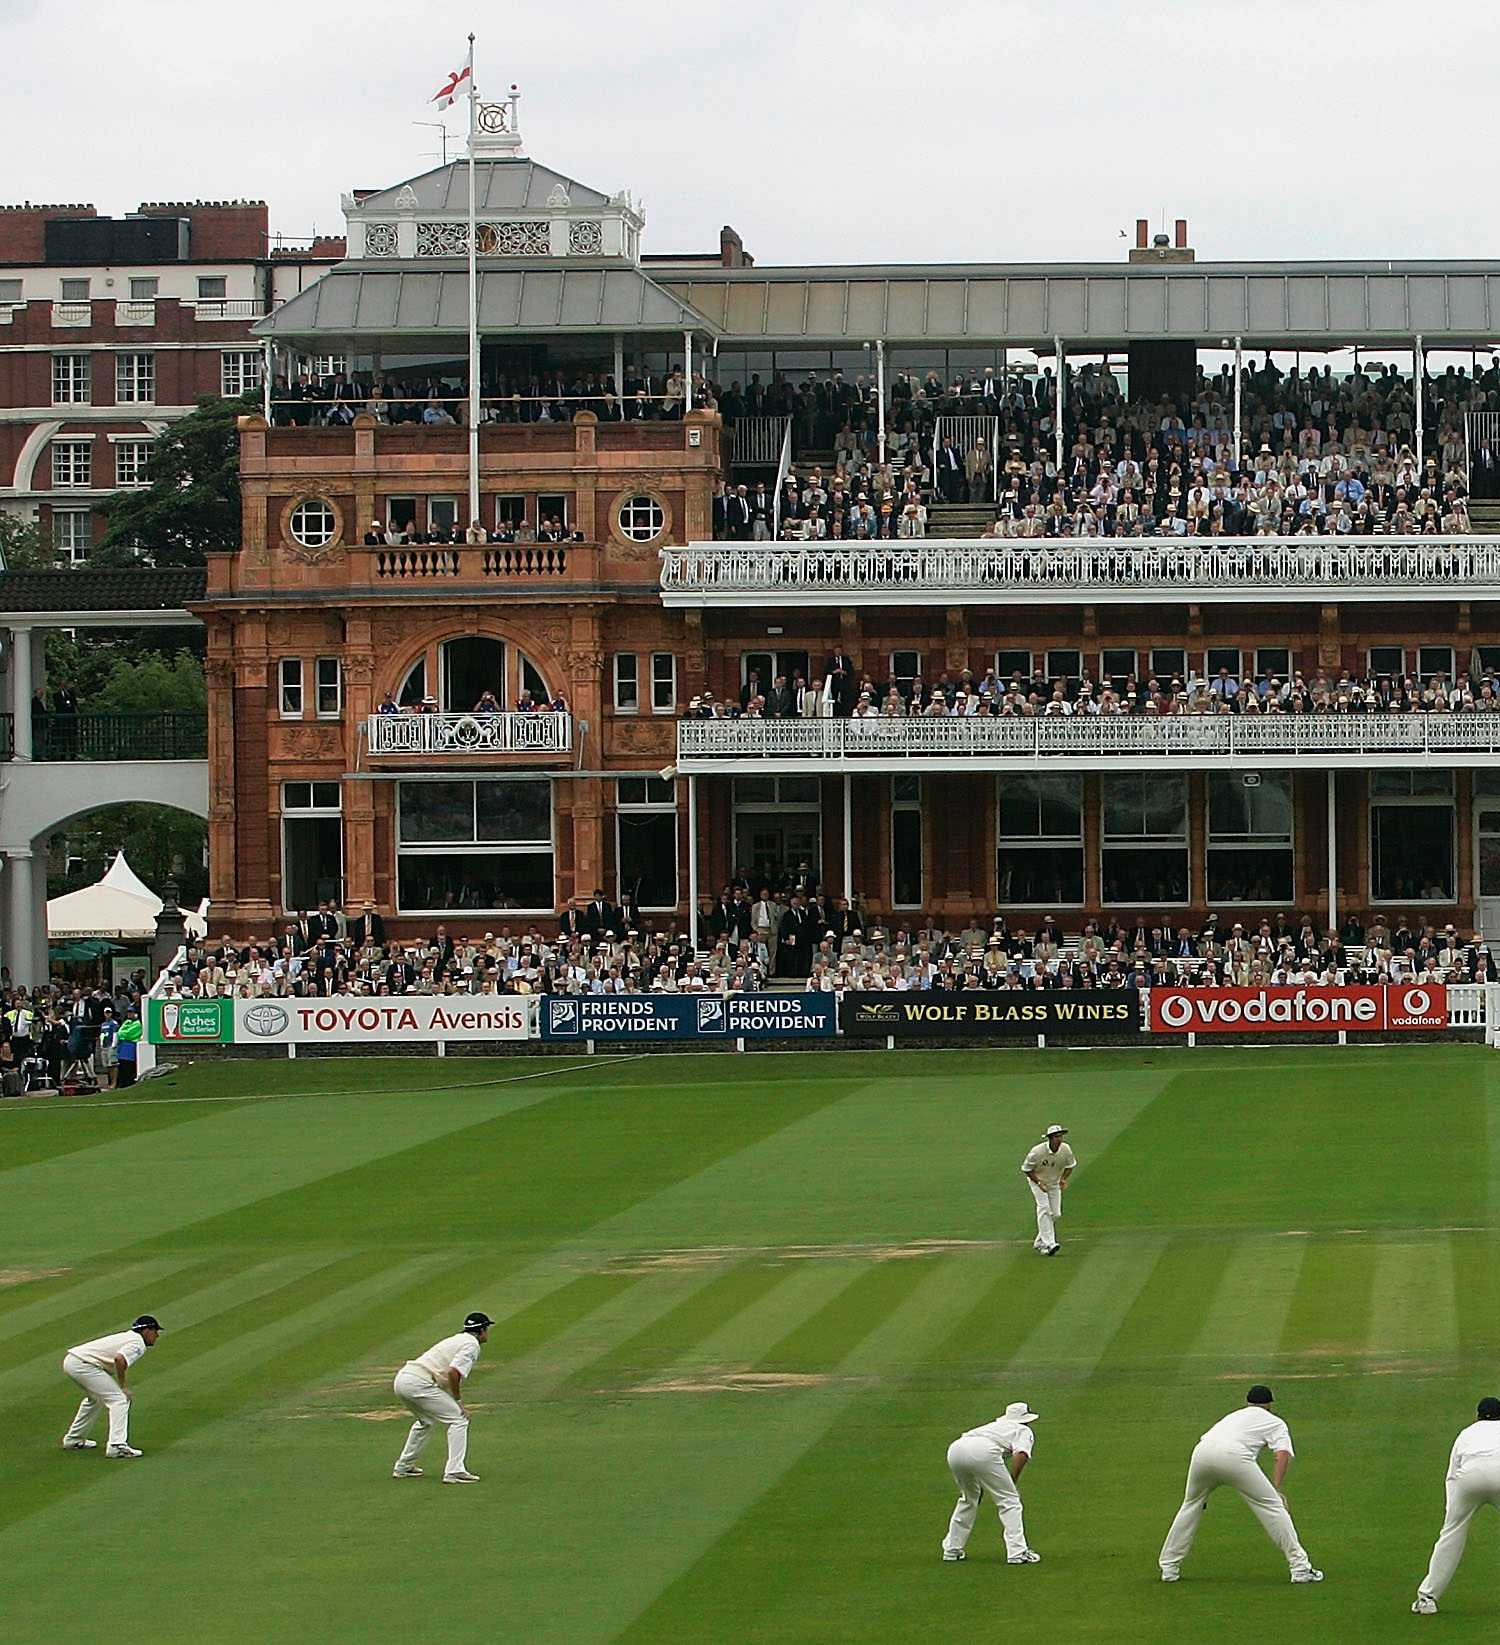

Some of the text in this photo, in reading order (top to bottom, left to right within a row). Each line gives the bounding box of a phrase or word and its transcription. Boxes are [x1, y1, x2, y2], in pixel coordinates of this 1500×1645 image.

[582, 1002, 654, 1015] FRIENDS
[729, 999, 801, 1013] FRIENDS
[904, 1003, 1129, 1021] WOLF BLASS WINES
[1197, 990, 1377, 1023] vodafone
[182, 1016, 216, 1026] Ashes
[297, 1006, 522, 1031] TOYOTA Avensis
[582, 1018, 679, 1031] PROVIDENT
[729, 1015, 827, 1030] PROVIDENT
